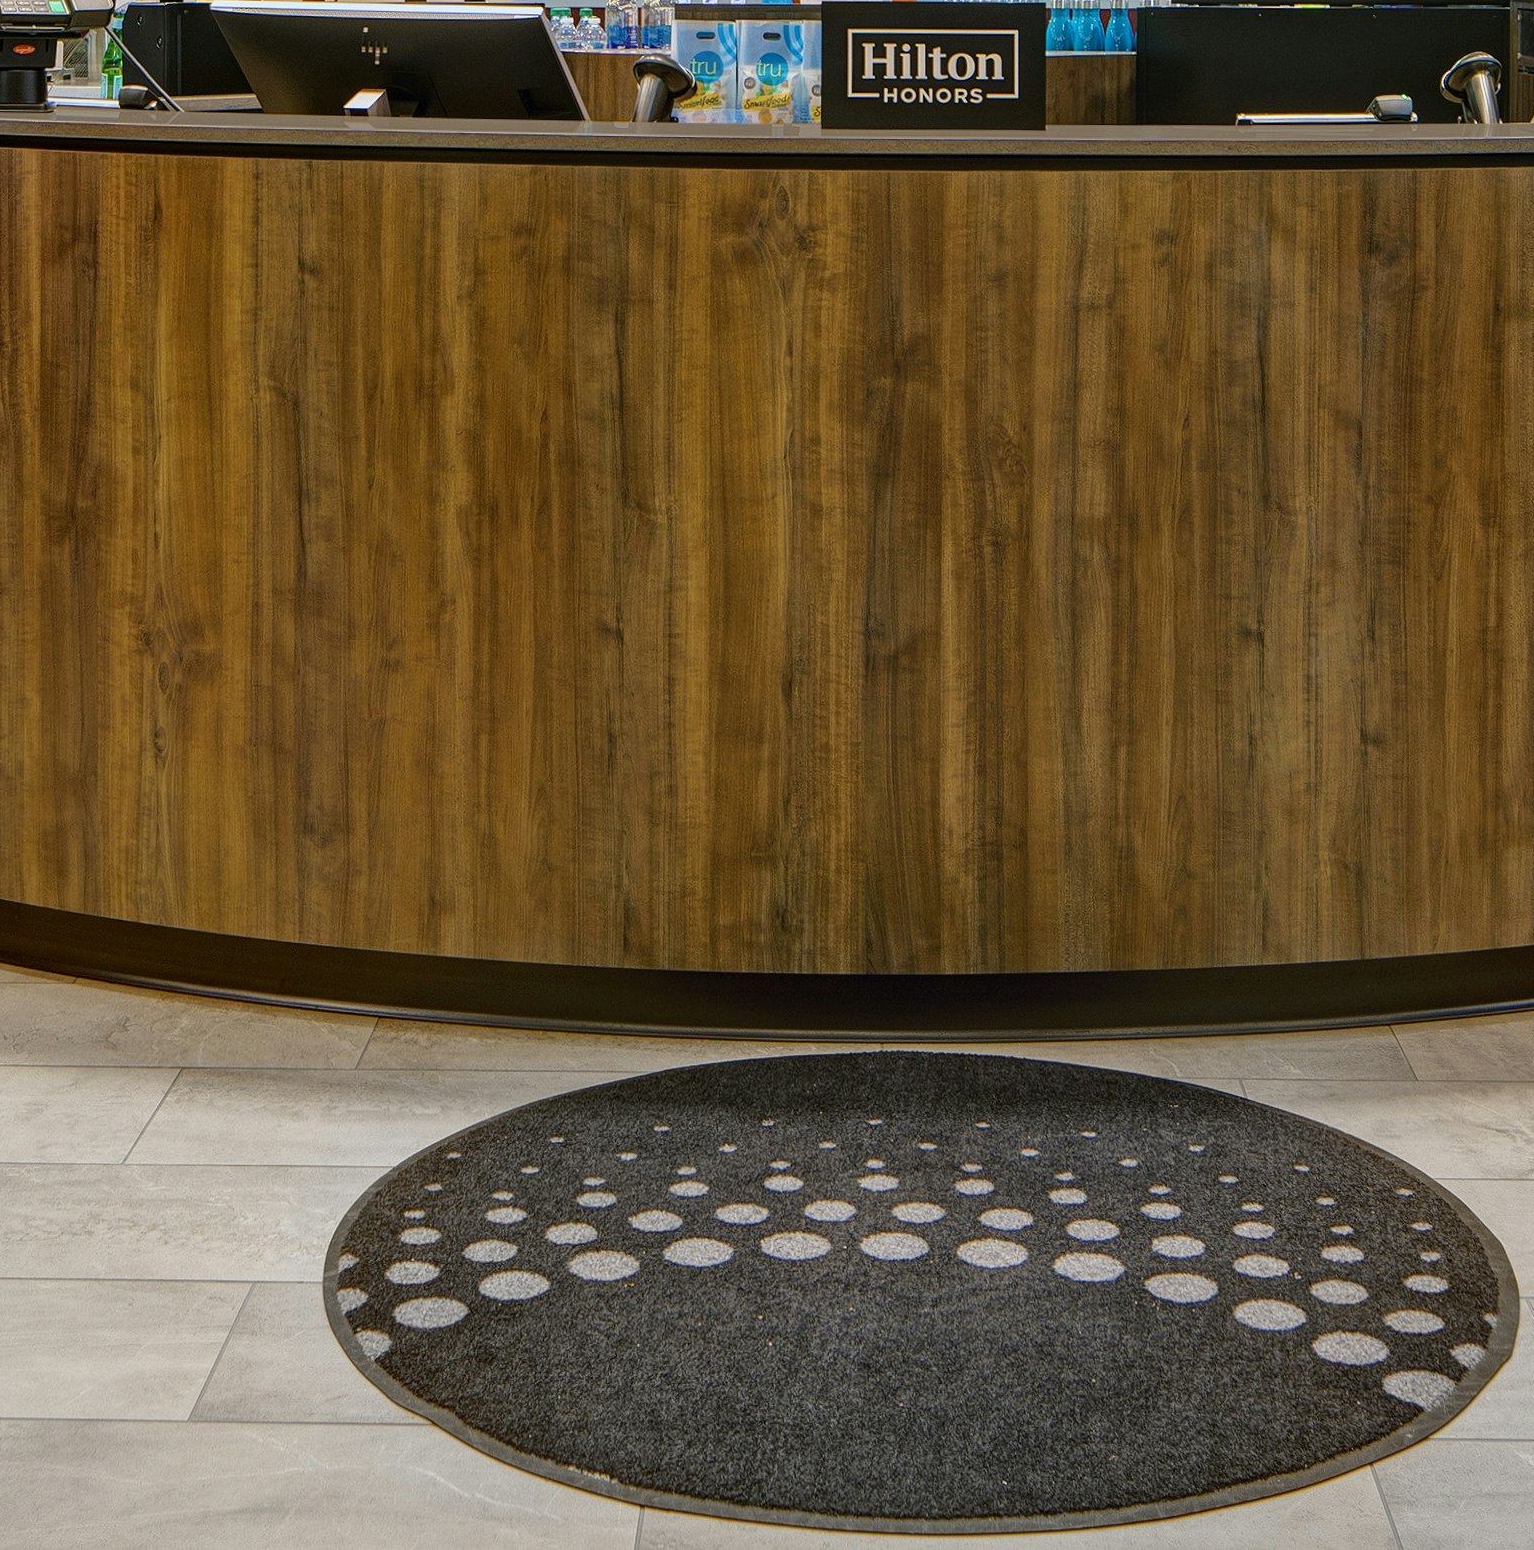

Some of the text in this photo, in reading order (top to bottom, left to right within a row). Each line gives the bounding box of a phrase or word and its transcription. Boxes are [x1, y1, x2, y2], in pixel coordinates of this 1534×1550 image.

[690, 58, 717, 75] tru
[756, 59, 782, 78] tru
[861, 42, 1005, 81] Hilton
[883, 87, 984, 104] HONORS
